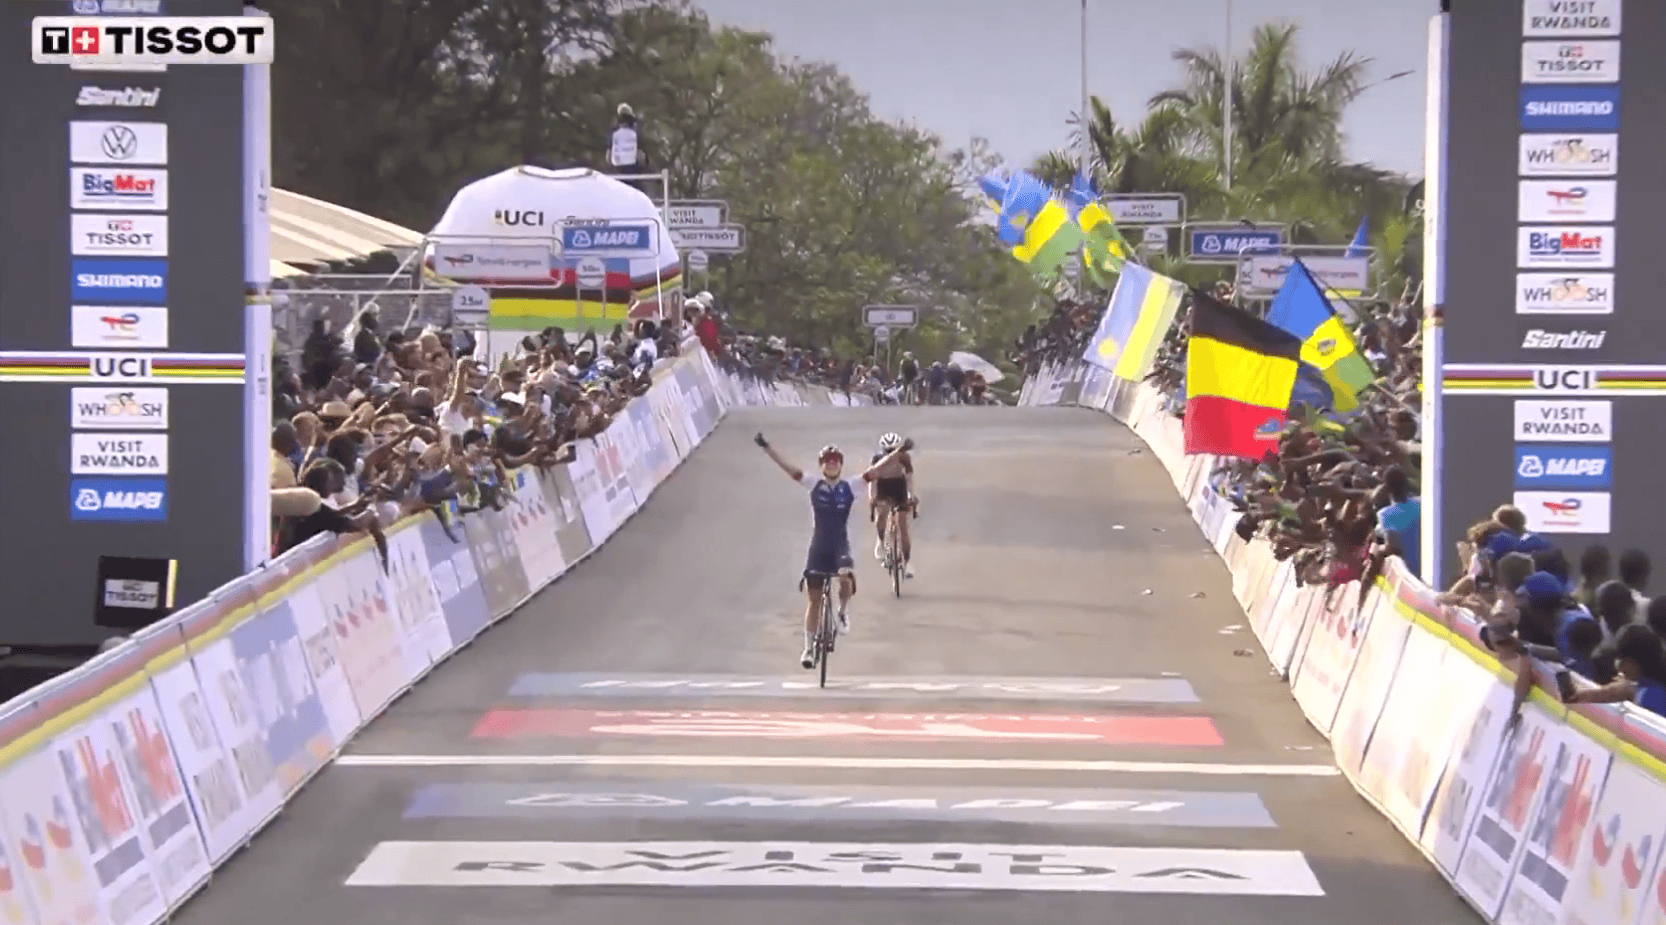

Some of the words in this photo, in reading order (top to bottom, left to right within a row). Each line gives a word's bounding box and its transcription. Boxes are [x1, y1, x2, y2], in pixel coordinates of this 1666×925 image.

[1549, 2, 1595, 12] VISIT
[1532, 16, 1611, 29] RWANDA
[1537, 60, 1605, 71] TISSOT
[75, 86, 161, 107] Santini
[1525, 100, 1613, 116] SHIMANO
[83, 173, 155, 193] BigMat
[504, 210, 544, 226] UCI
[86, 232, 154, 245] TISSOT
[593, 231, 640, 246] MAPEI
[1530, 232, 1602, 254] BigMat
[77, 273, 163, 288] SHIMANO
[1521, 329, 1607, 349] Santini
[94, 358, 147, 379] UCI
[1538, 371, 1590, 390] UCI
[1541, 407, 1586, 420] VISIT
[1523, 422, 1603, 434] RWANDA
[98, 440, 143, 453] VISIT
[80, 455, 160, 467] RWANDA
[1546, 458, 1606, 476] MAPEI
[103, 491, 164, 509] MAPEI
[701, 795, 1186, 812] MAPEI
[623, 849, 1067, 862] VISIT
[453, 860, 1250, 880] RWANDA
